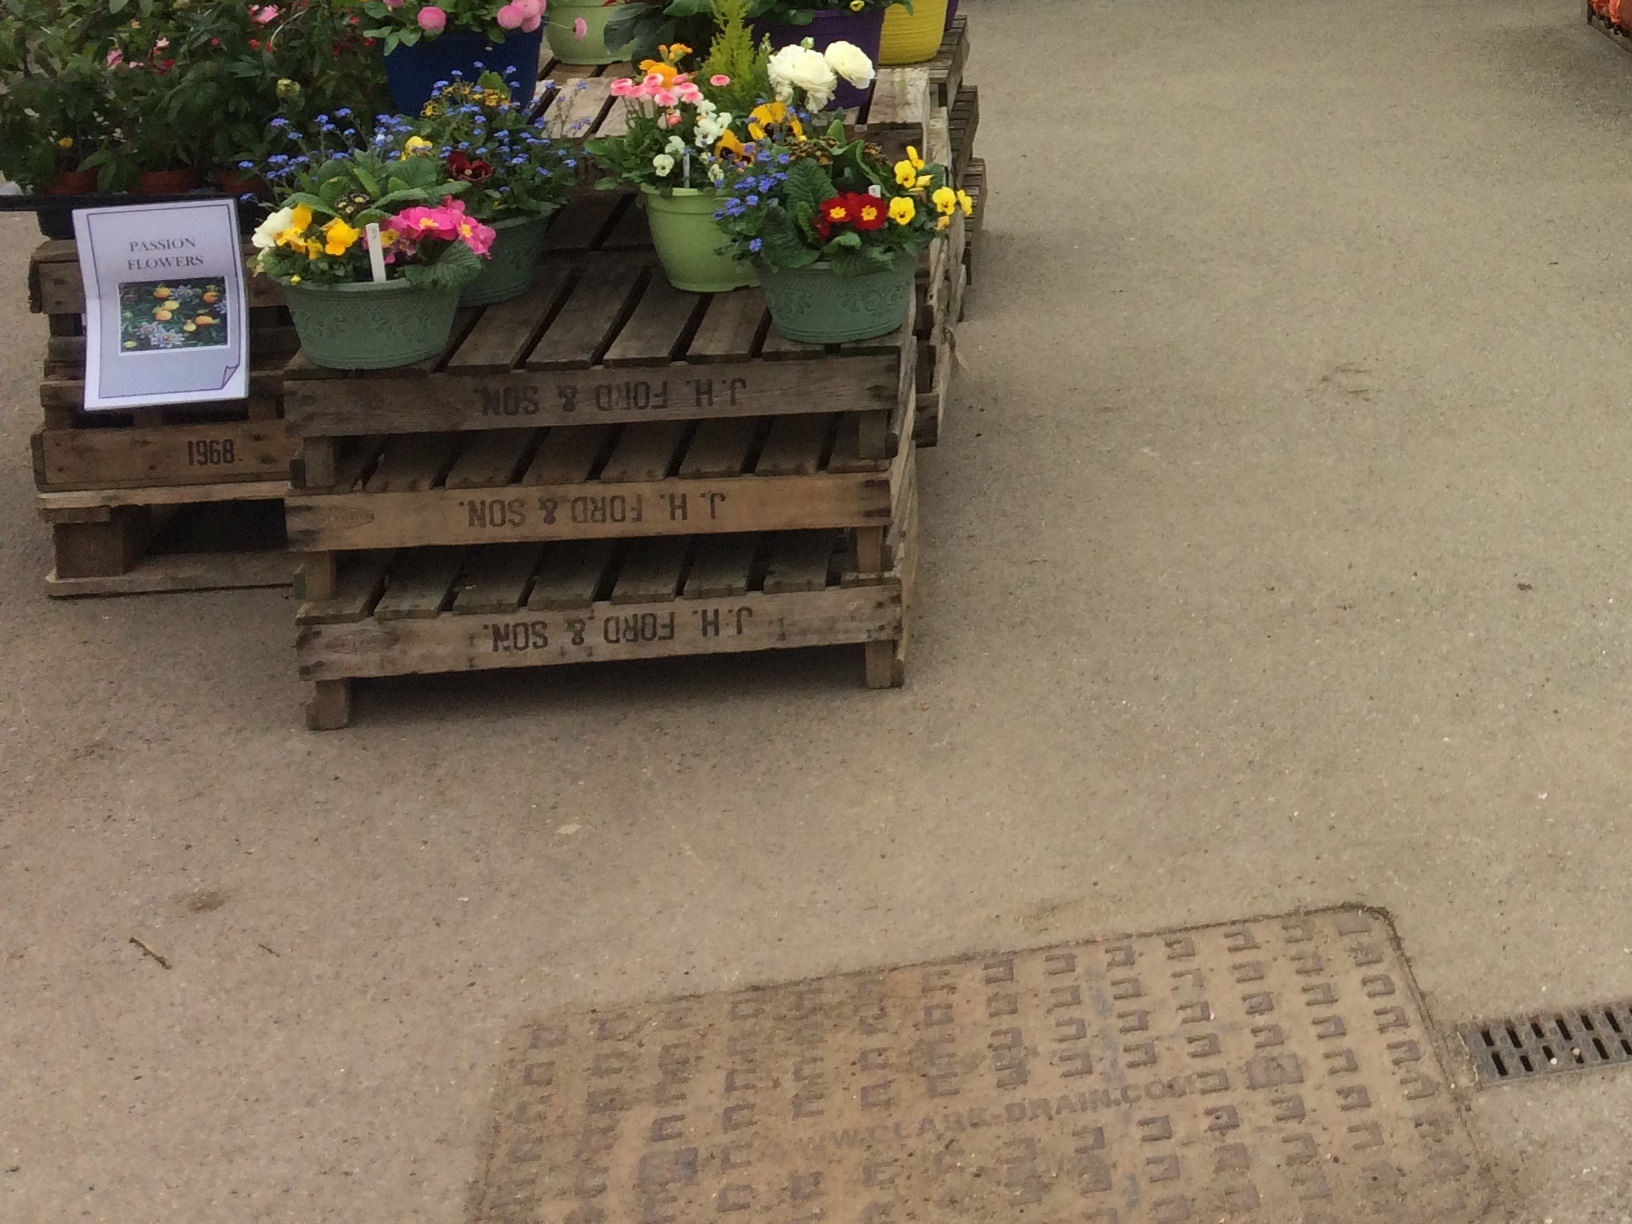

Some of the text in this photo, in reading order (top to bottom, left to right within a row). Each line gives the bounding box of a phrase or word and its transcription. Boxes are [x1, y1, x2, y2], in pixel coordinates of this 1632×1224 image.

[129, 237, 196, 252] PASSION
[127, 255, 204, 270] FLOWERS
[557, 384, 578, 412] &
[595, 380, 669, 411] FORD
[538, 496, 558, 526] &
[571, 494, 643, 524] FORD
[565, 617, 586, 645] &
[603, 610, 675, 643] FORD
